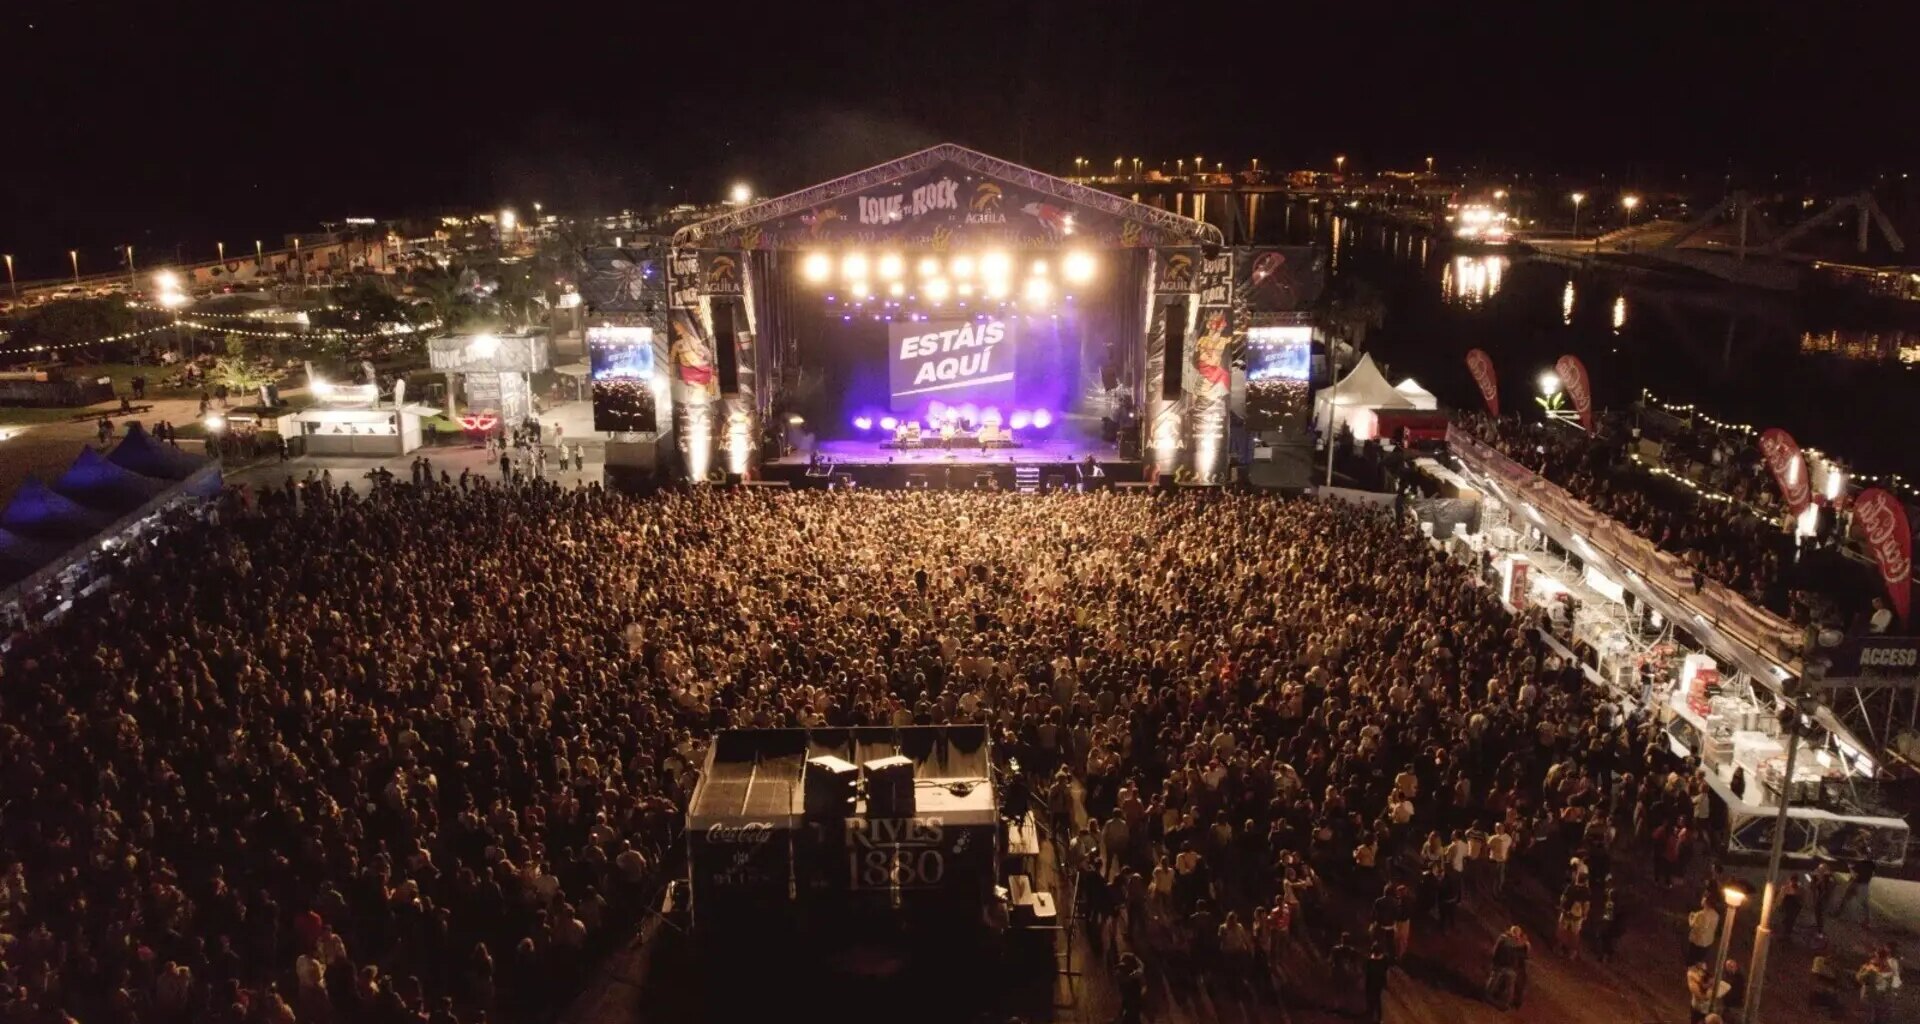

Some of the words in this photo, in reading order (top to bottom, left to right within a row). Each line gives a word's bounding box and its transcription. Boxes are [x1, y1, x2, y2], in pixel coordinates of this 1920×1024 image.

[859, 194, 904, 225] LOVE
[912, 179, 960, 217] ROCK
[900, 320, 1006, 360] ESTÁIS
[913, 345, 995, 385] AQUÍ
[1860, 647, 1917, 666] ACCESO
[844, 816, 944, 849] RIVES
[849, 849, 945, 891] 1880
